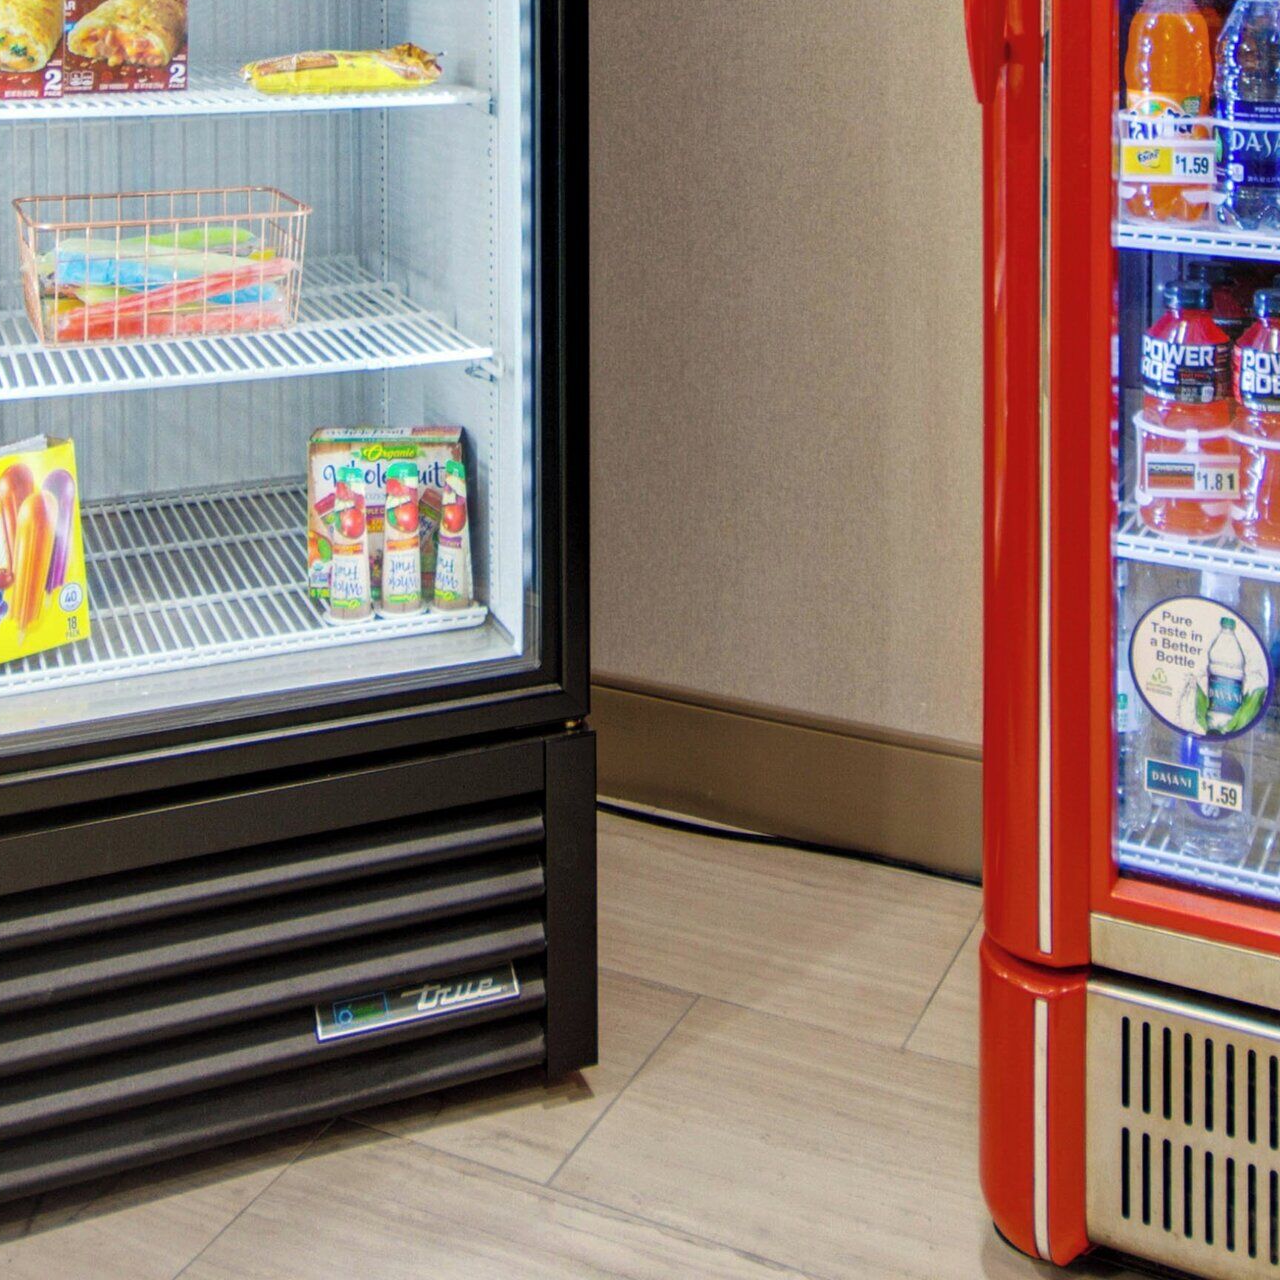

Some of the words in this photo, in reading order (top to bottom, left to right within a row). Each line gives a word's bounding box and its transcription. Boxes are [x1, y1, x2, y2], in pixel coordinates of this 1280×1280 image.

[44, 69, 63, 91] 2
[170, 63, 186, 84] 2
[1176, 154, 1209, 174] $1.59
[1142, 334, 1216, 367] POWER
[363, 444, 415, 461] Organic
[1197, 472, 1234, 490] $1.81
[65, 590, 77, 603] 40
[67, 616, 77, 630] 18
[1162, 610, 1193, 627] Pure
[1151, 621, 1188, 640] Taste
[1191, 629, 1203, 643] in
[1150, 638, 1158, 647] a
[1161, 636, 1203, 657] Better
[1156, 650, 1196, 669] Bottle
[1151, 770, 1193, 789] DASANI
[1201, 781, 1238, 807] $1.59
[400, 978, 502, 1011] true
